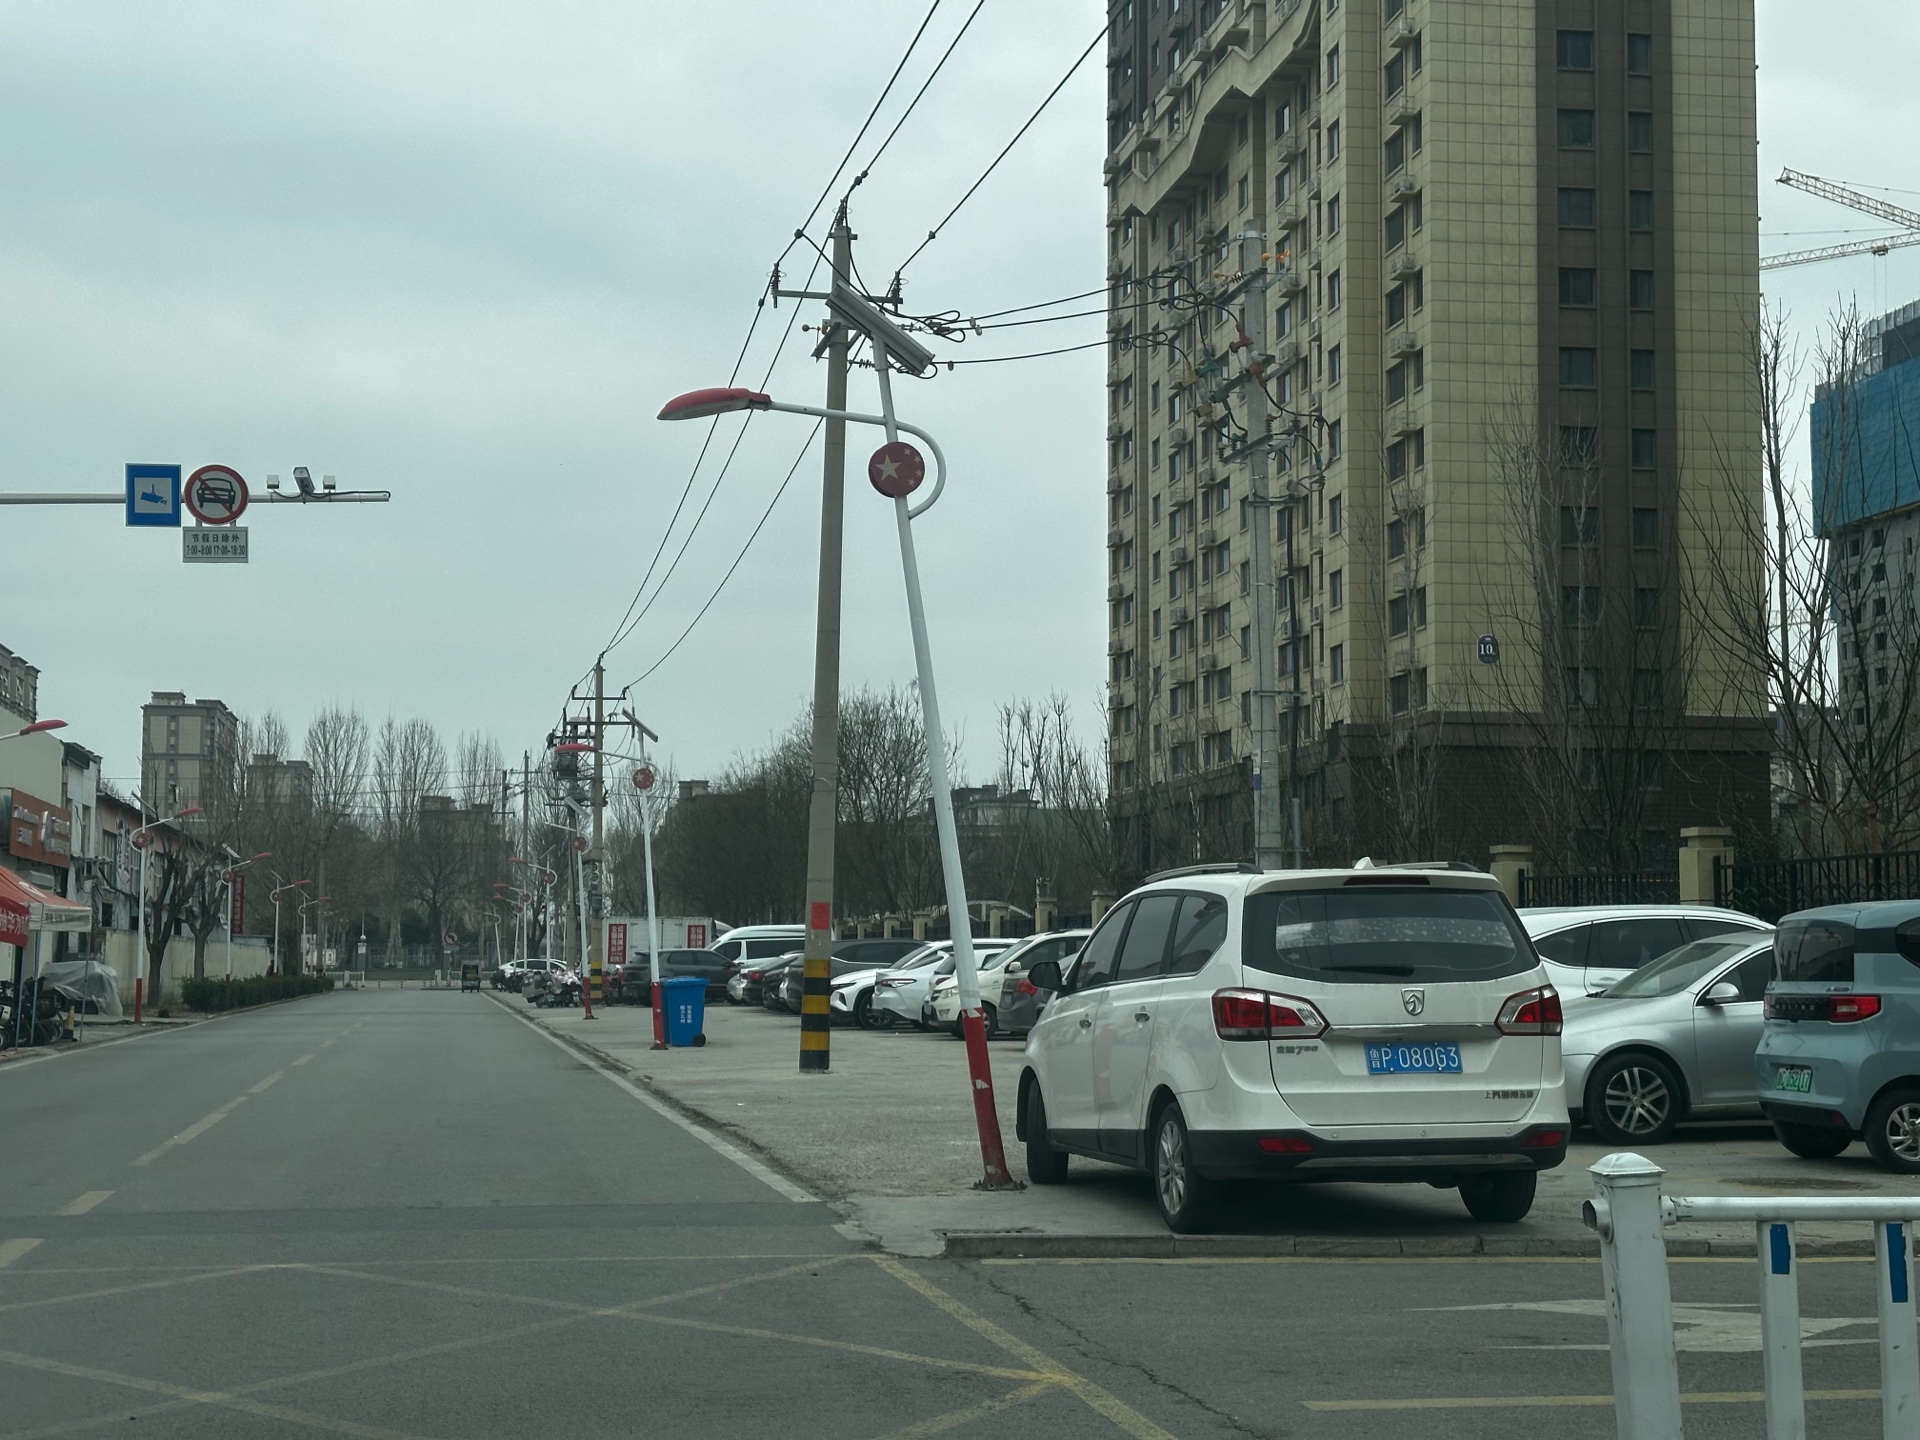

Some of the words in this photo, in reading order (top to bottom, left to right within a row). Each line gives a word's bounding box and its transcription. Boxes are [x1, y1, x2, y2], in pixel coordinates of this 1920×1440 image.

[191, 533, 240, 543] 节假日除外
